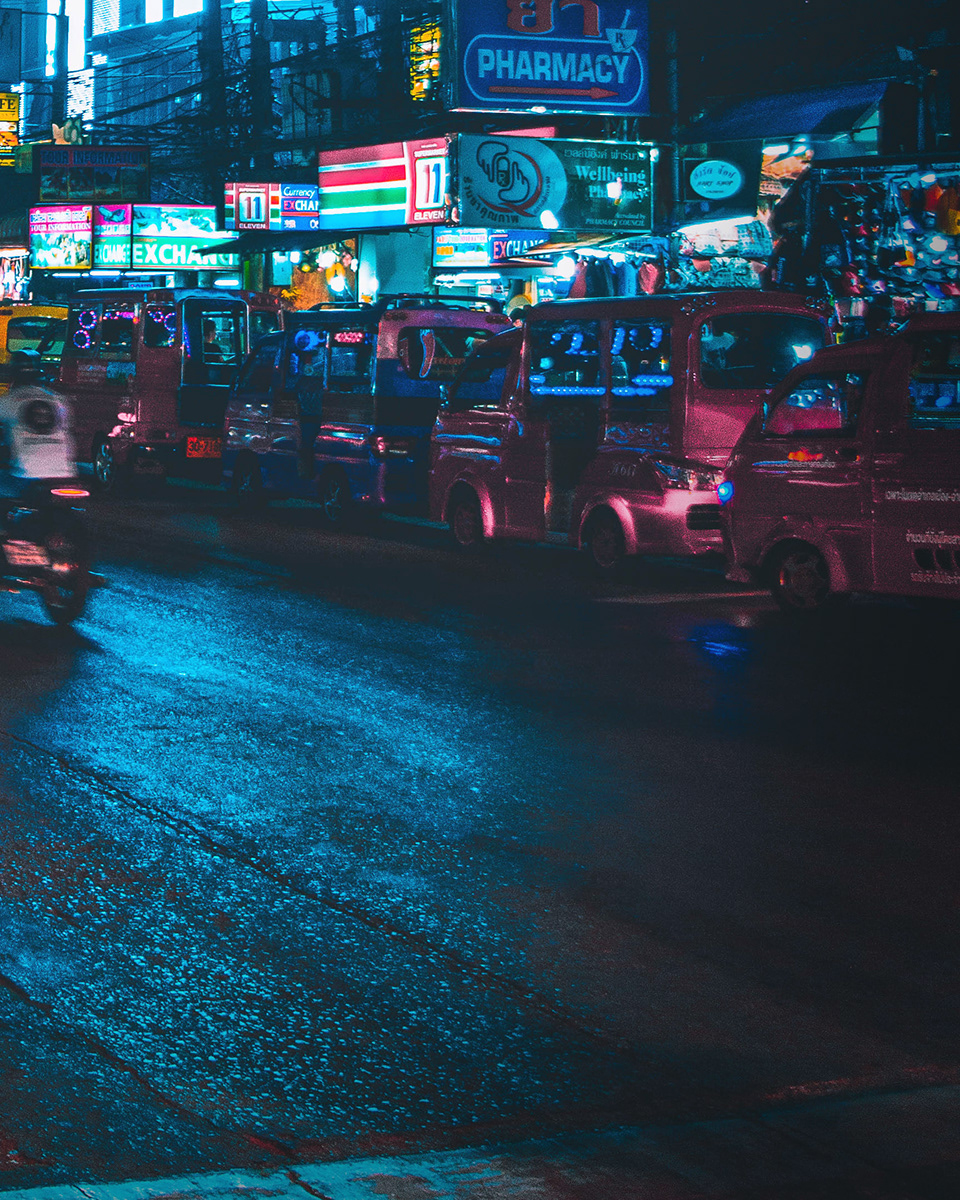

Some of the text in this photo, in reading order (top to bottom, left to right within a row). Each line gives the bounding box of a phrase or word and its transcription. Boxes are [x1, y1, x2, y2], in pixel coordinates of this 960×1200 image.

[477, 49, 630, 84] PHARMACY
[41, 150, 147, 166] TOUR INFORMATION
[423, 163, 441, 204] 11
[575, 166, 646, 187] Wellbeing
[283, 187, 316, 199] Currency
[244, 196, 261, 219] 11
[414, 211, 444, 221] ELEVEN
[31, 224, 47, 232] TOUR
[48, 223, 91, 232] INFORMATION
